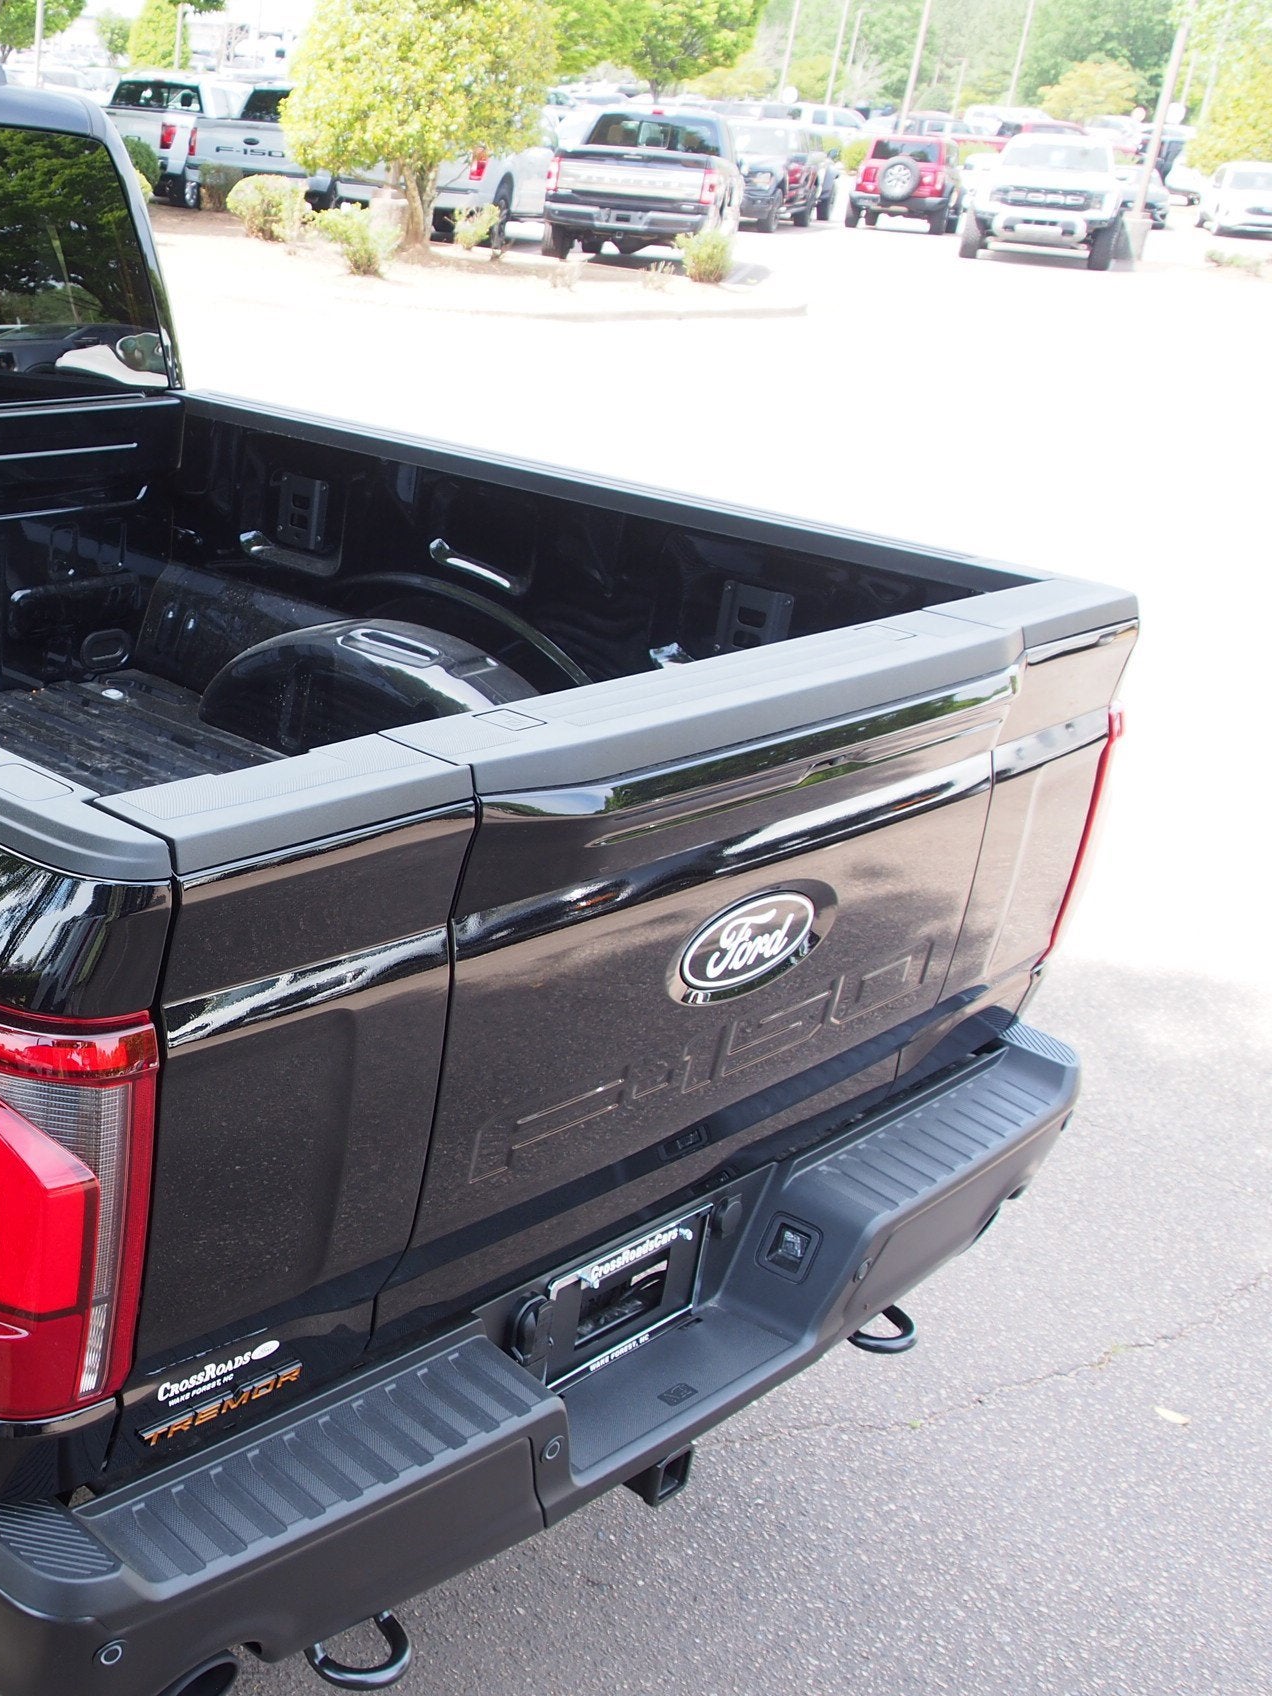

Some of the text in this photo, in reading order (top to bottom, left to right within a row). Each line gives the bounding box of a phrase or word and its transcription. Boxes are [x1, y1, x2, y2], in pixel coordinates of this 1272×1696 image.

[216, 146, 285, 158] F-150
[1008, 191, 1085, 205] FORD
[705, 907, 795, 978] Ford
[589, 1333, 650, 1372] WAKE FOREST, NC
[142, 1362, 304, 1447] TREMOR
[168, 1373, 235, 1407] WAKE FOREST, NC
